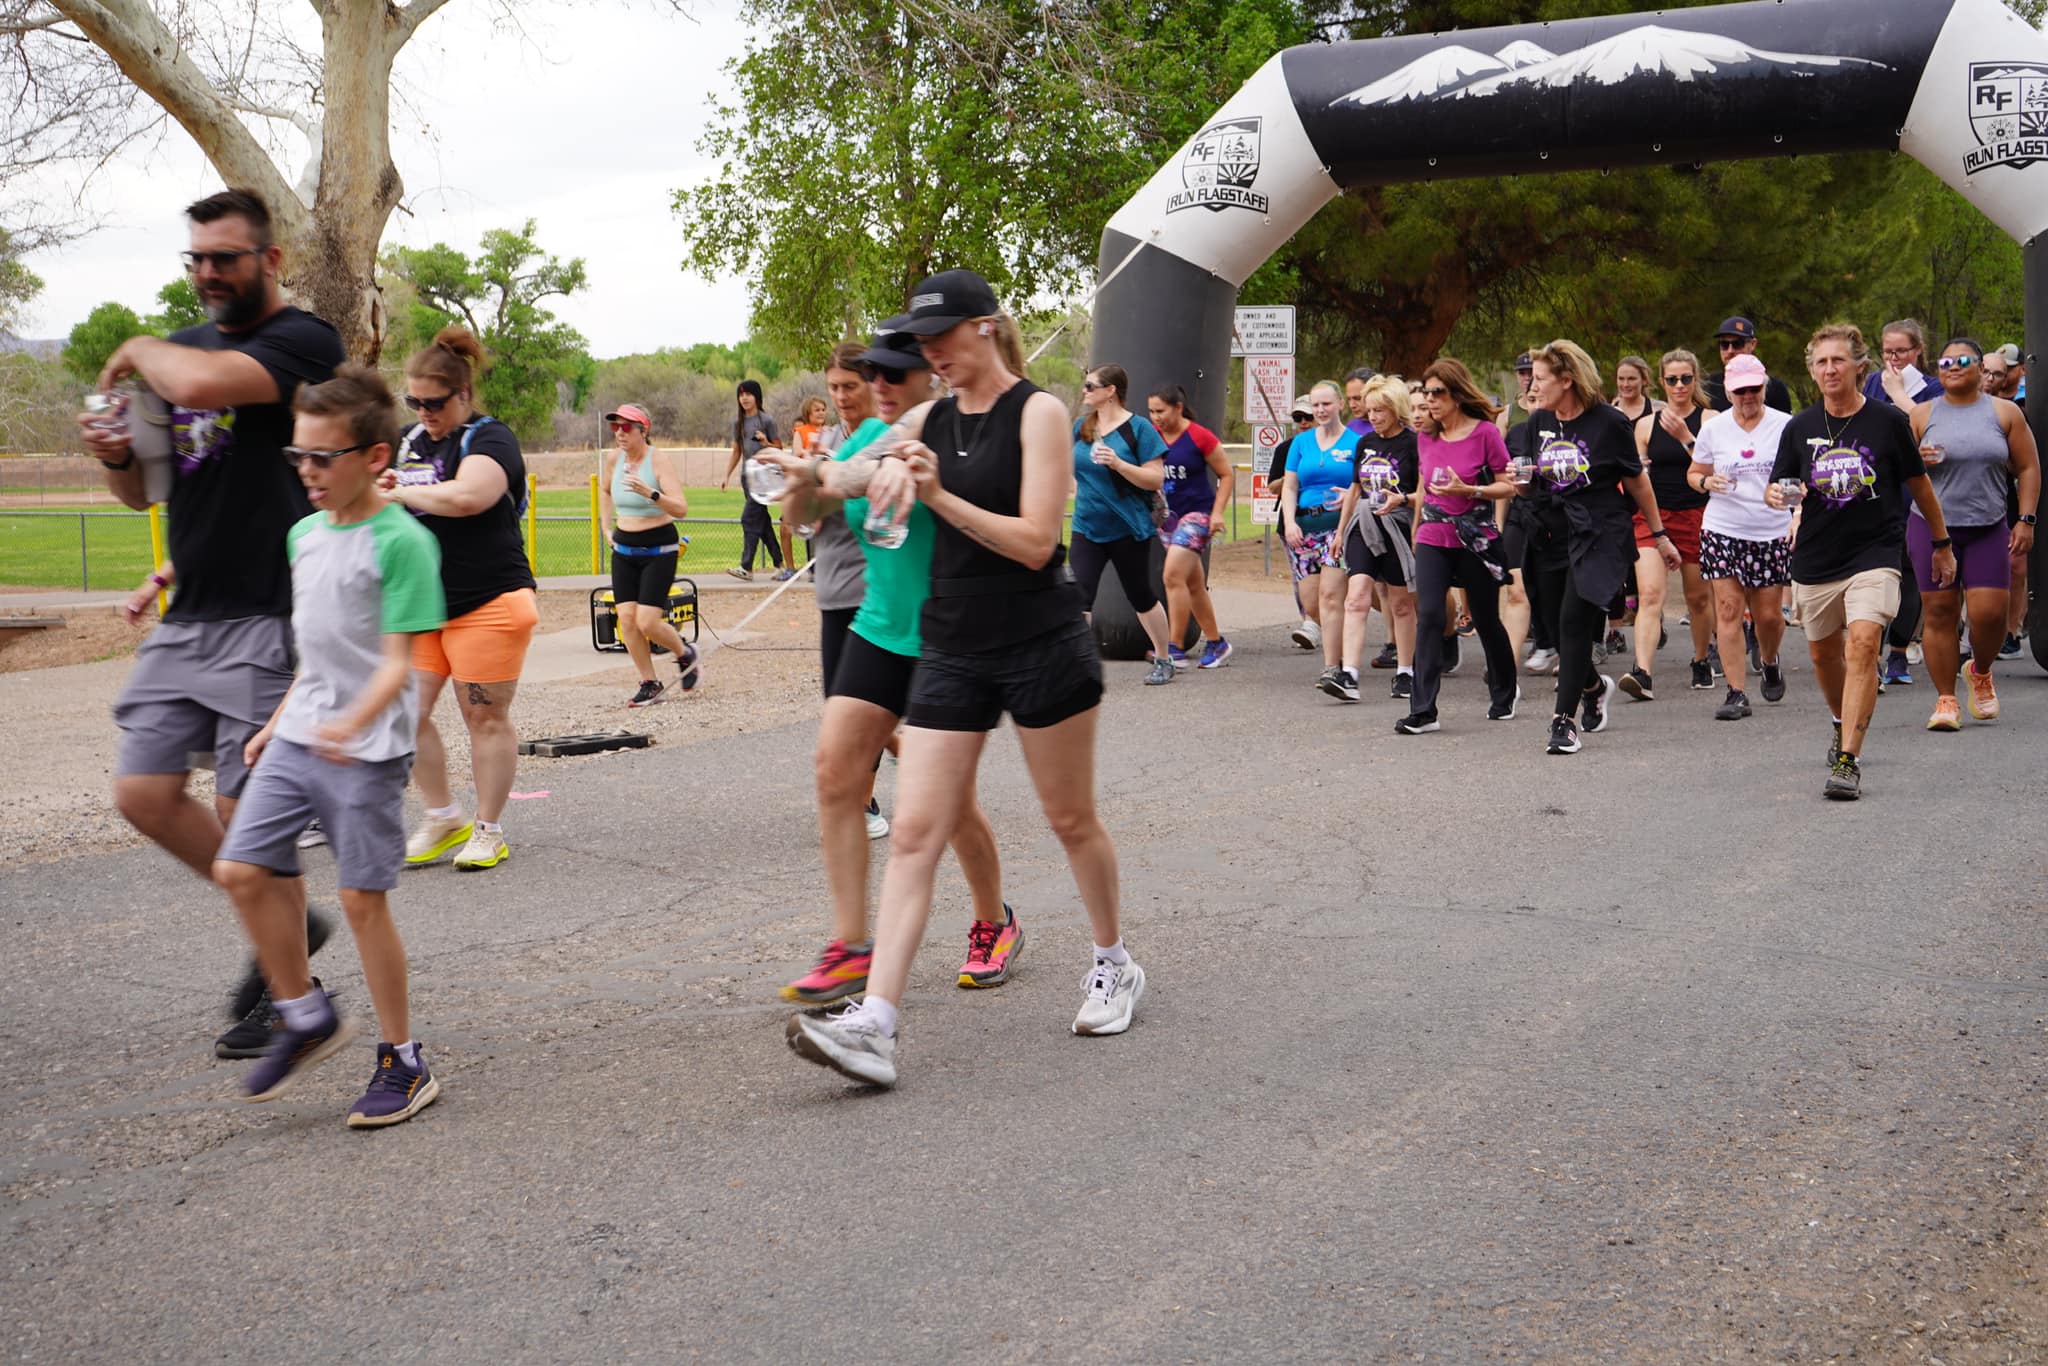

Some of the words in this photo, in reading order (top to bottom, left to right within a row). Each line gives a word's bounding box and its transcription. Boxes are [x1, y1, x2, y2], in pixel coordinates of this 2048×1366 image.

[1976, 85, 2012, 111] RF
[1191, 142, 1215, 161] RF
[1966, 146, 1994, 169] RUN
[1170, 190, 1194, 208] RUN
[1197, 187, 1265, 208] FLAGSTAFF
[1275, 368, 1288, 376] LAW
